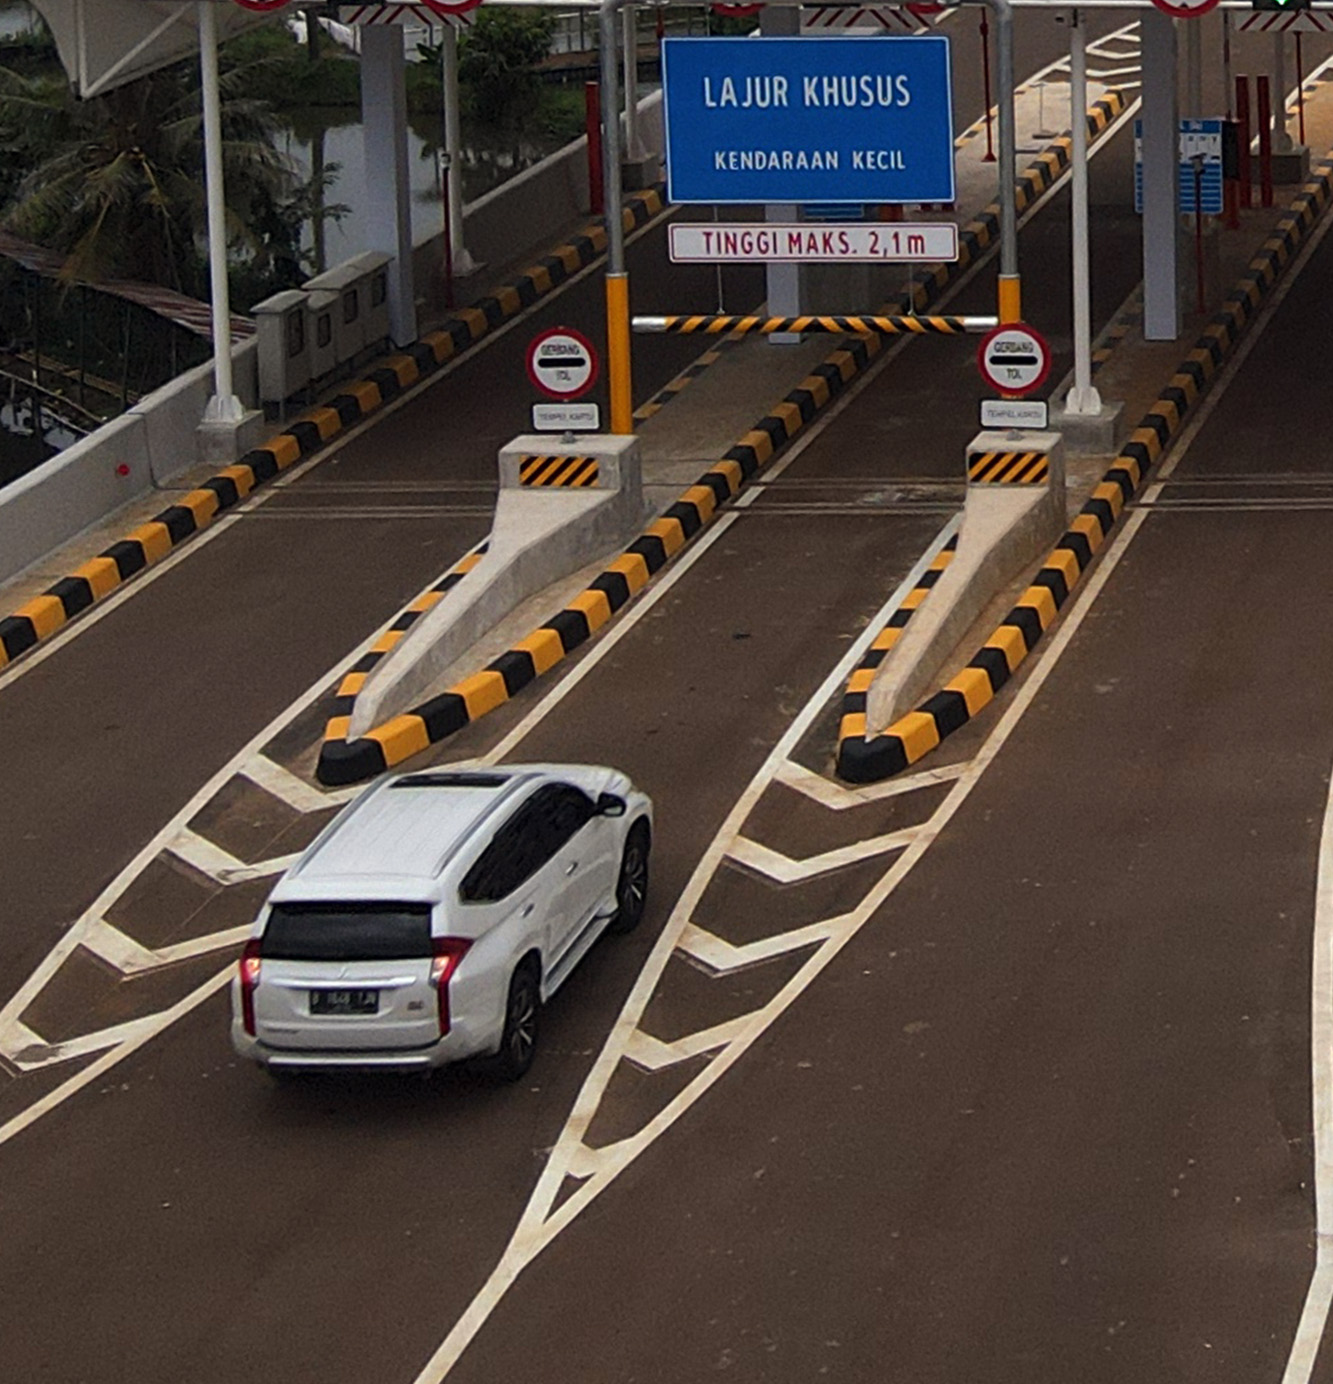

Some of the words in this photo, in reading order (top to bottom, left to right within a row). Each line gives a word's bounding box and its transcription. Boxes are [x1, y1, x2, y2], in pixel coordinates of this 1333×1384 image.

[703, 76, 789, 108] LAJUR
[803, 75, 911, 107] KHUSUS
[714, 150, 839, 171] KENDARAAN
[852, 149, 906, 170] KECIL
[702, 231, 778, 256] TINGGI
[788, 231, 858, 255] MAKS.
[1006, 367, 1022, 380] TOL
